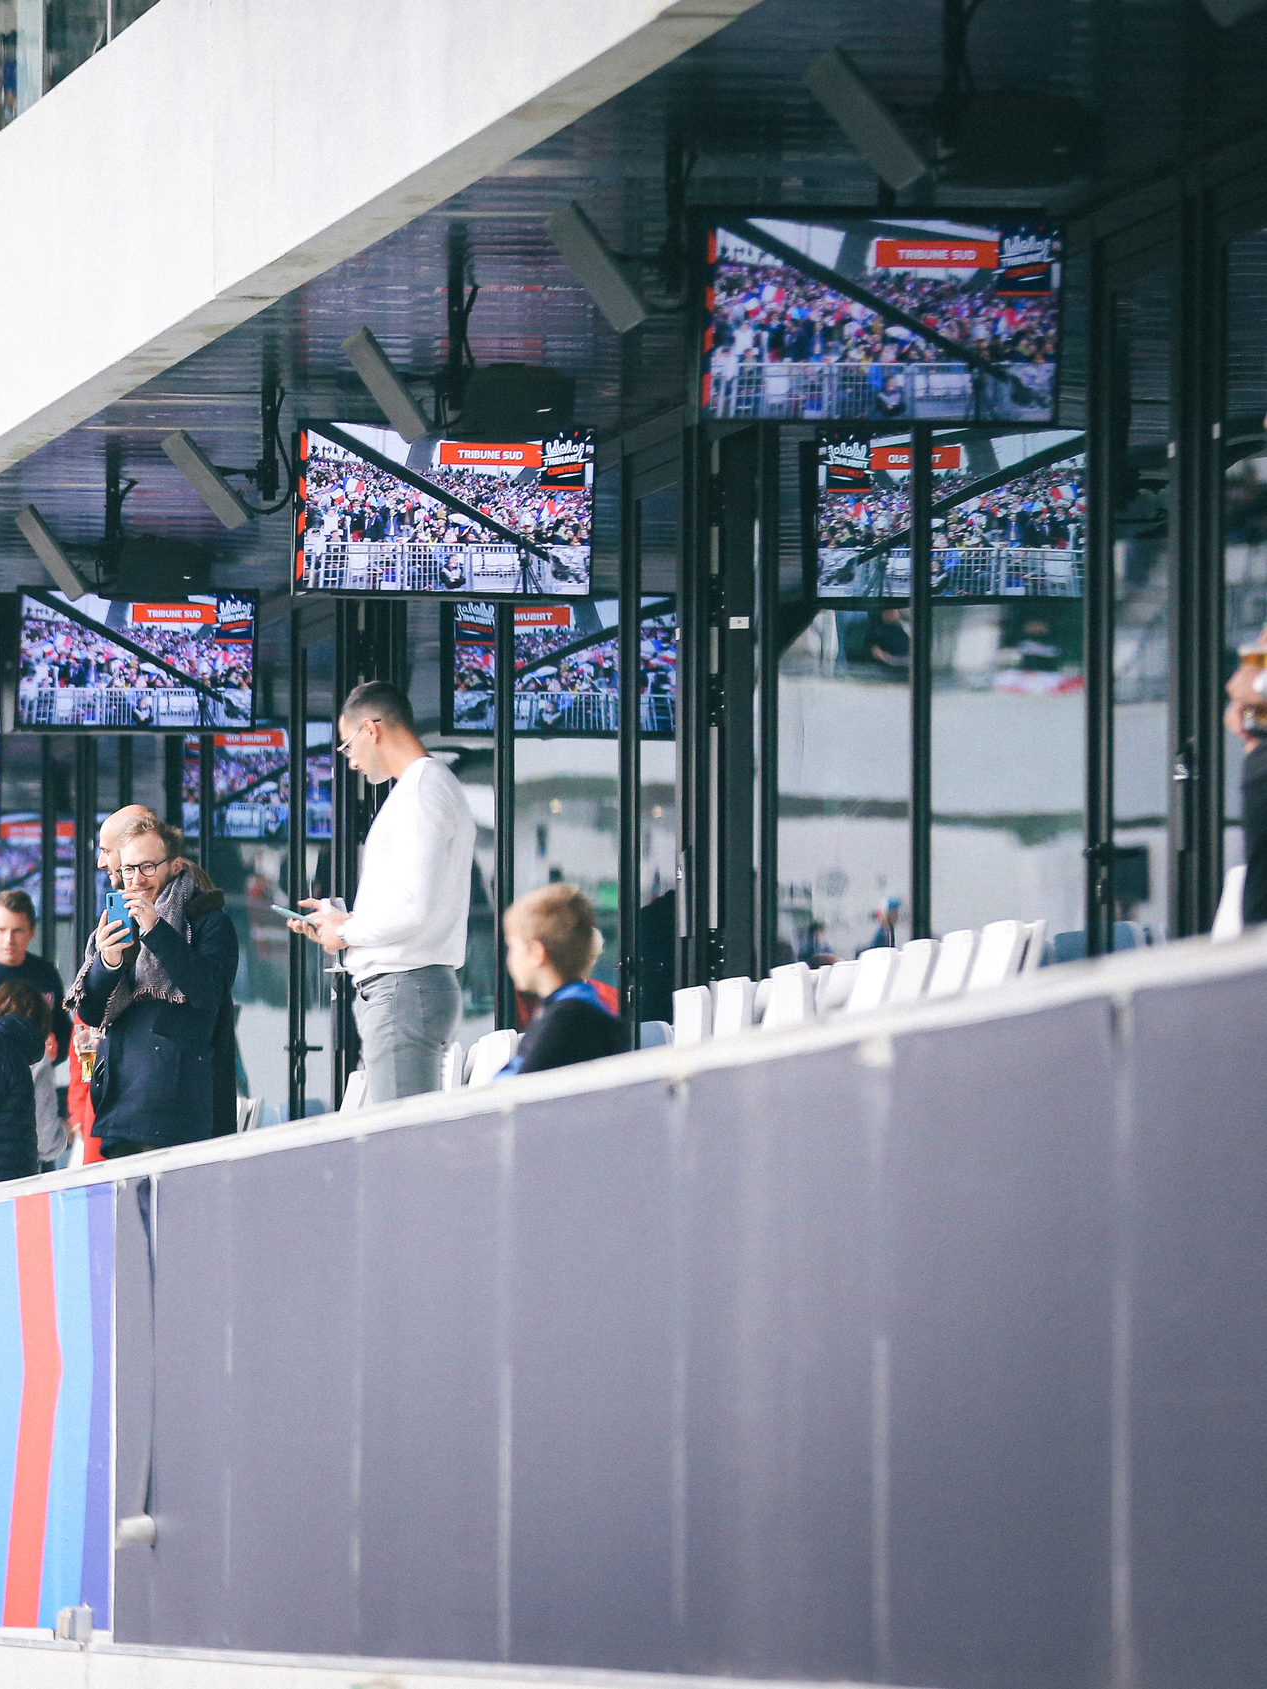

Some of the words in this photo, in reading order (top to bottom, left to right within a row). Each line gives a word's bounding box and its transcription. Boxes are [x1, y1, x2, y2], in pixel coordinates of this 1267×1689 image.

[897, 249, 950, 260] TRIBUNE
[951, 249, 977, 261] SUD
[456, 449, 501, 460] TRIBUNE
[502, 450, 524, 461] SUD
[543, 454, 579, 467] TRIBUNE
[547, 463, 584, 476] CONTEST
[146, 609, 183, 619] TRIBUNE
[183, 609, 202, 619] SUD
